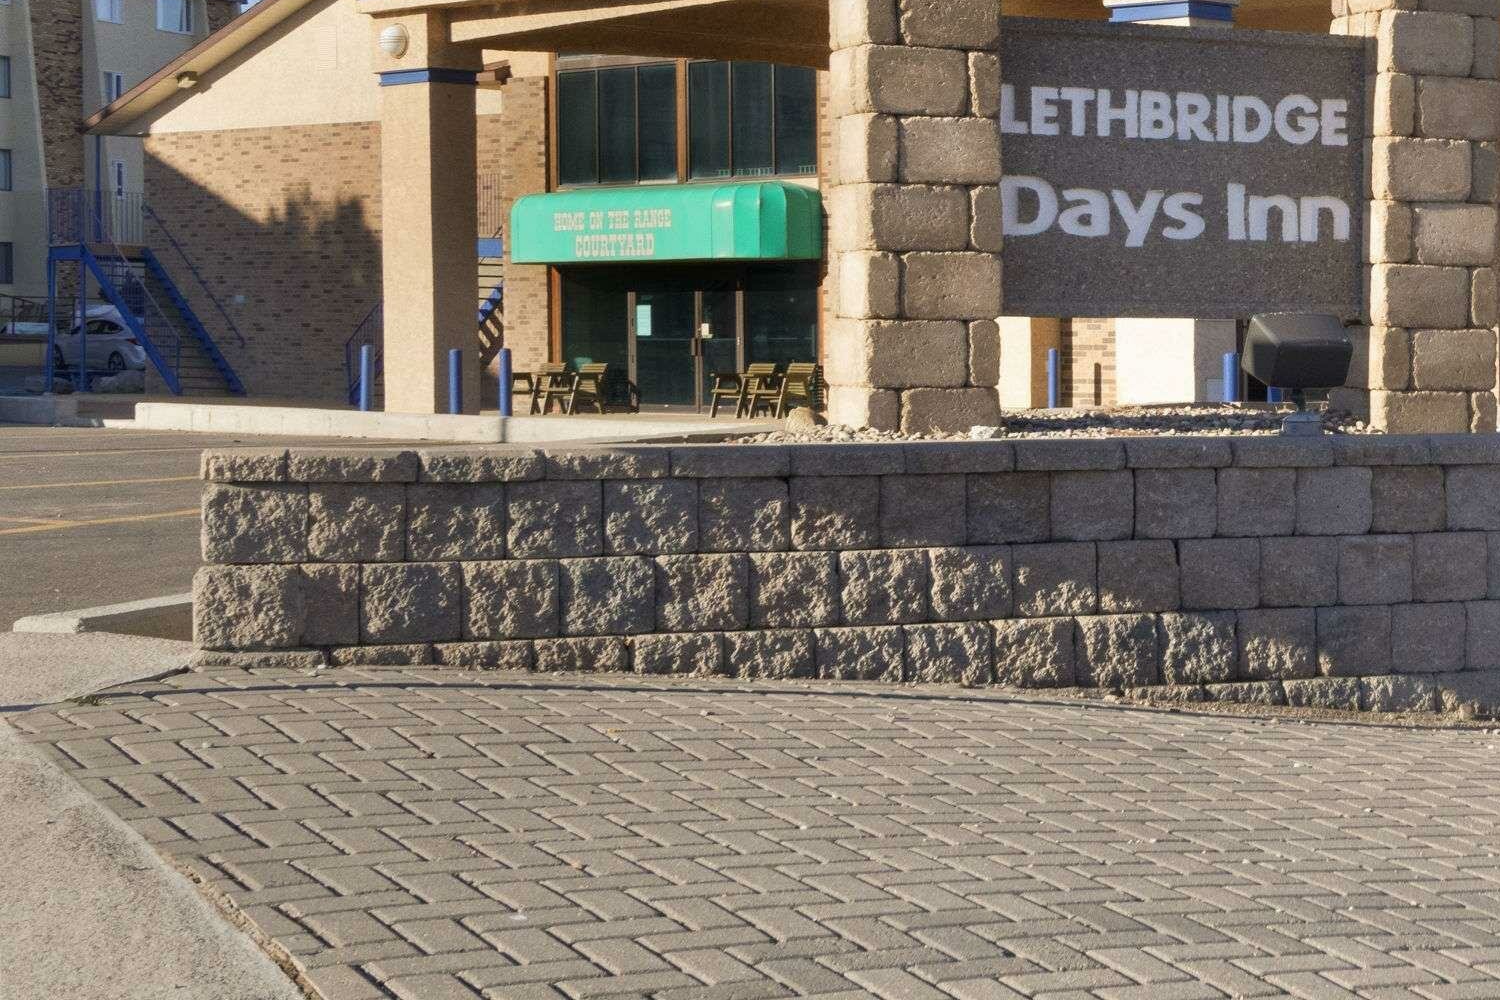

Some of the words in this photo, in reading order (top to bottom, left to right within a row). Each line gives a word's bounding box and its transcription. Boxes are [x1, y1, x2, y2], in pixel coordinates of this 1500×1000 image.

[1000, 83, 1349, 147] LETHBRIDGE
[554, 211, 585, 232] HOME
[589, 210, 604, 230] ON
[607, 209, 629, 229] THE
[634, 207, 672, 228] RANGE
[1000, 174, 1206, 248] Days
[1226, 183, 1351, 243] Inn
[575, 232, 656, 257] COURTYARD
